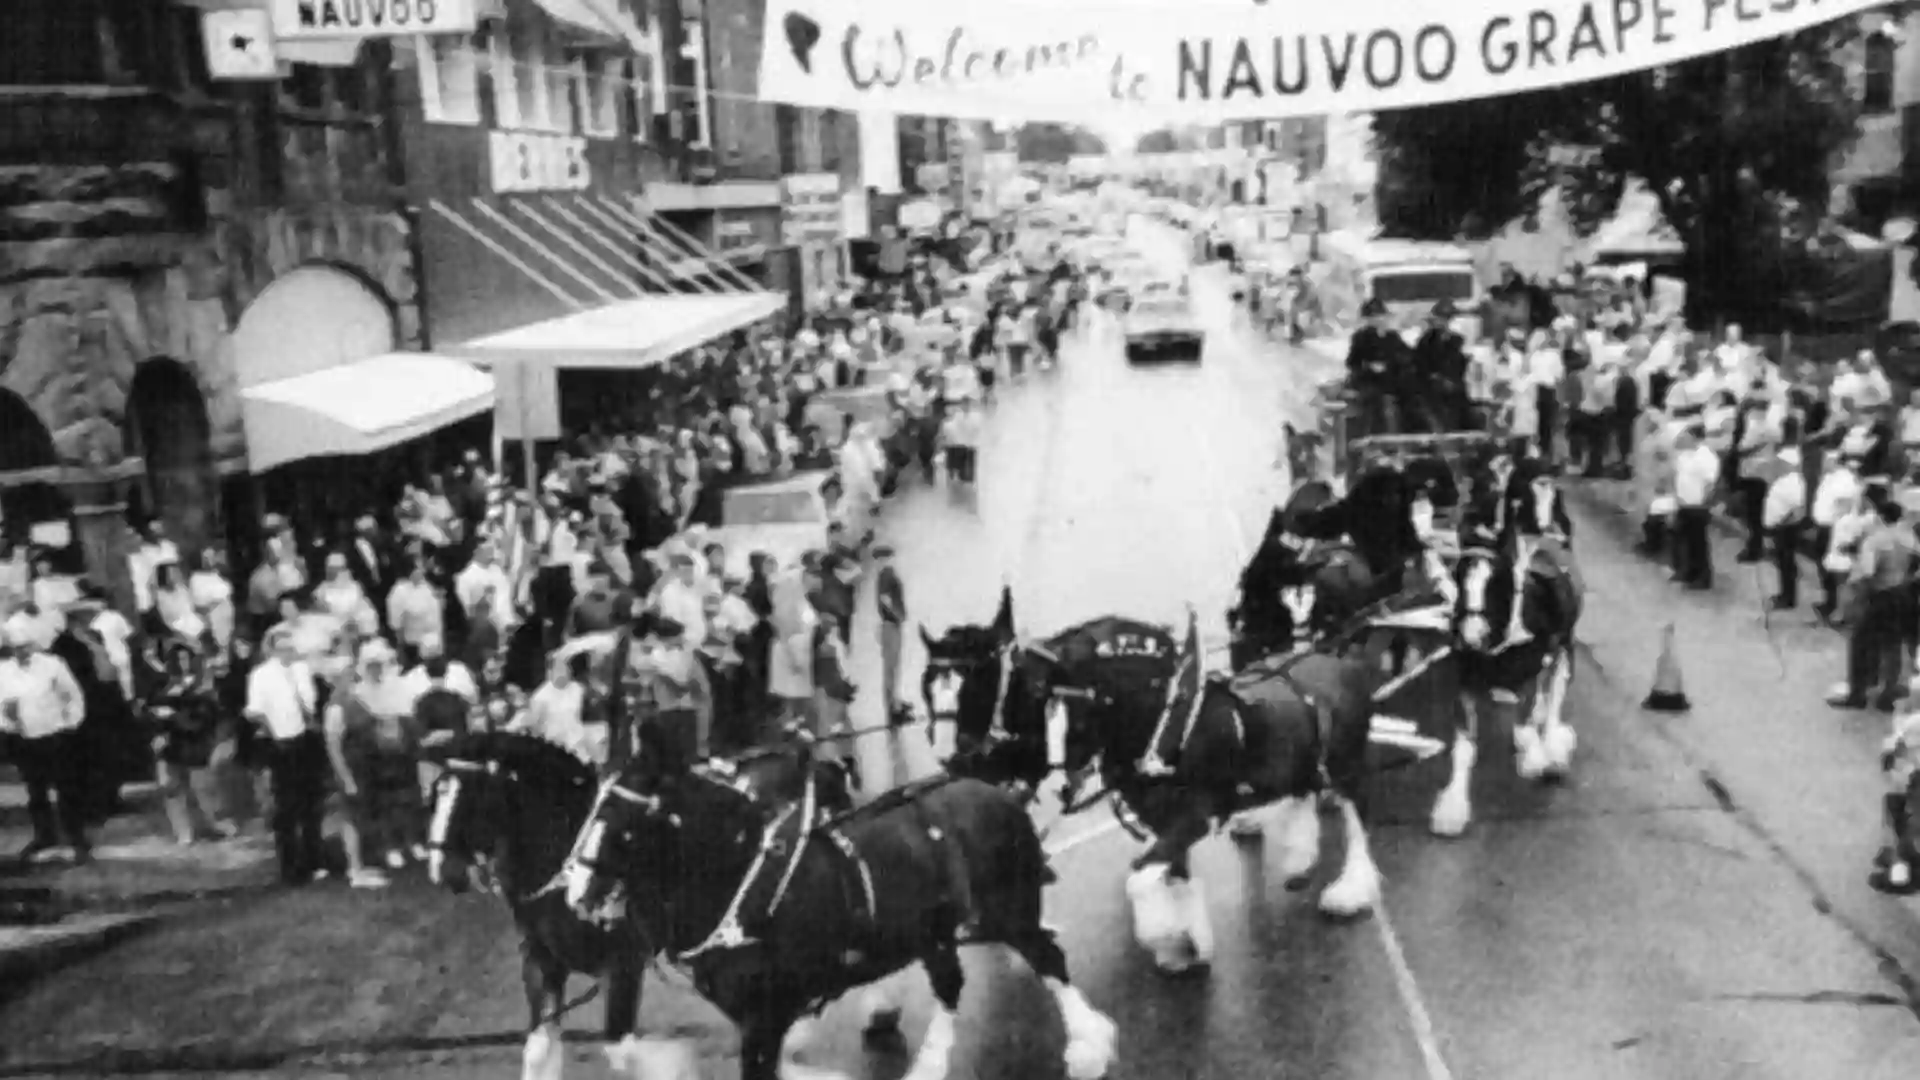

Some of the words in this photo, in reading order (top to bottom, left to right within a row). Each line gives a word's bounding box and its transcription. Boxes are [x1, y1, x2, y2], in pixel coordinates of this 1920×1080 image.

[298, 0, 437, 28] NAUVOO
[1176, 24, 1456, 100] NAUVOO
[1480, 0, 1676, 75] GRAPE
